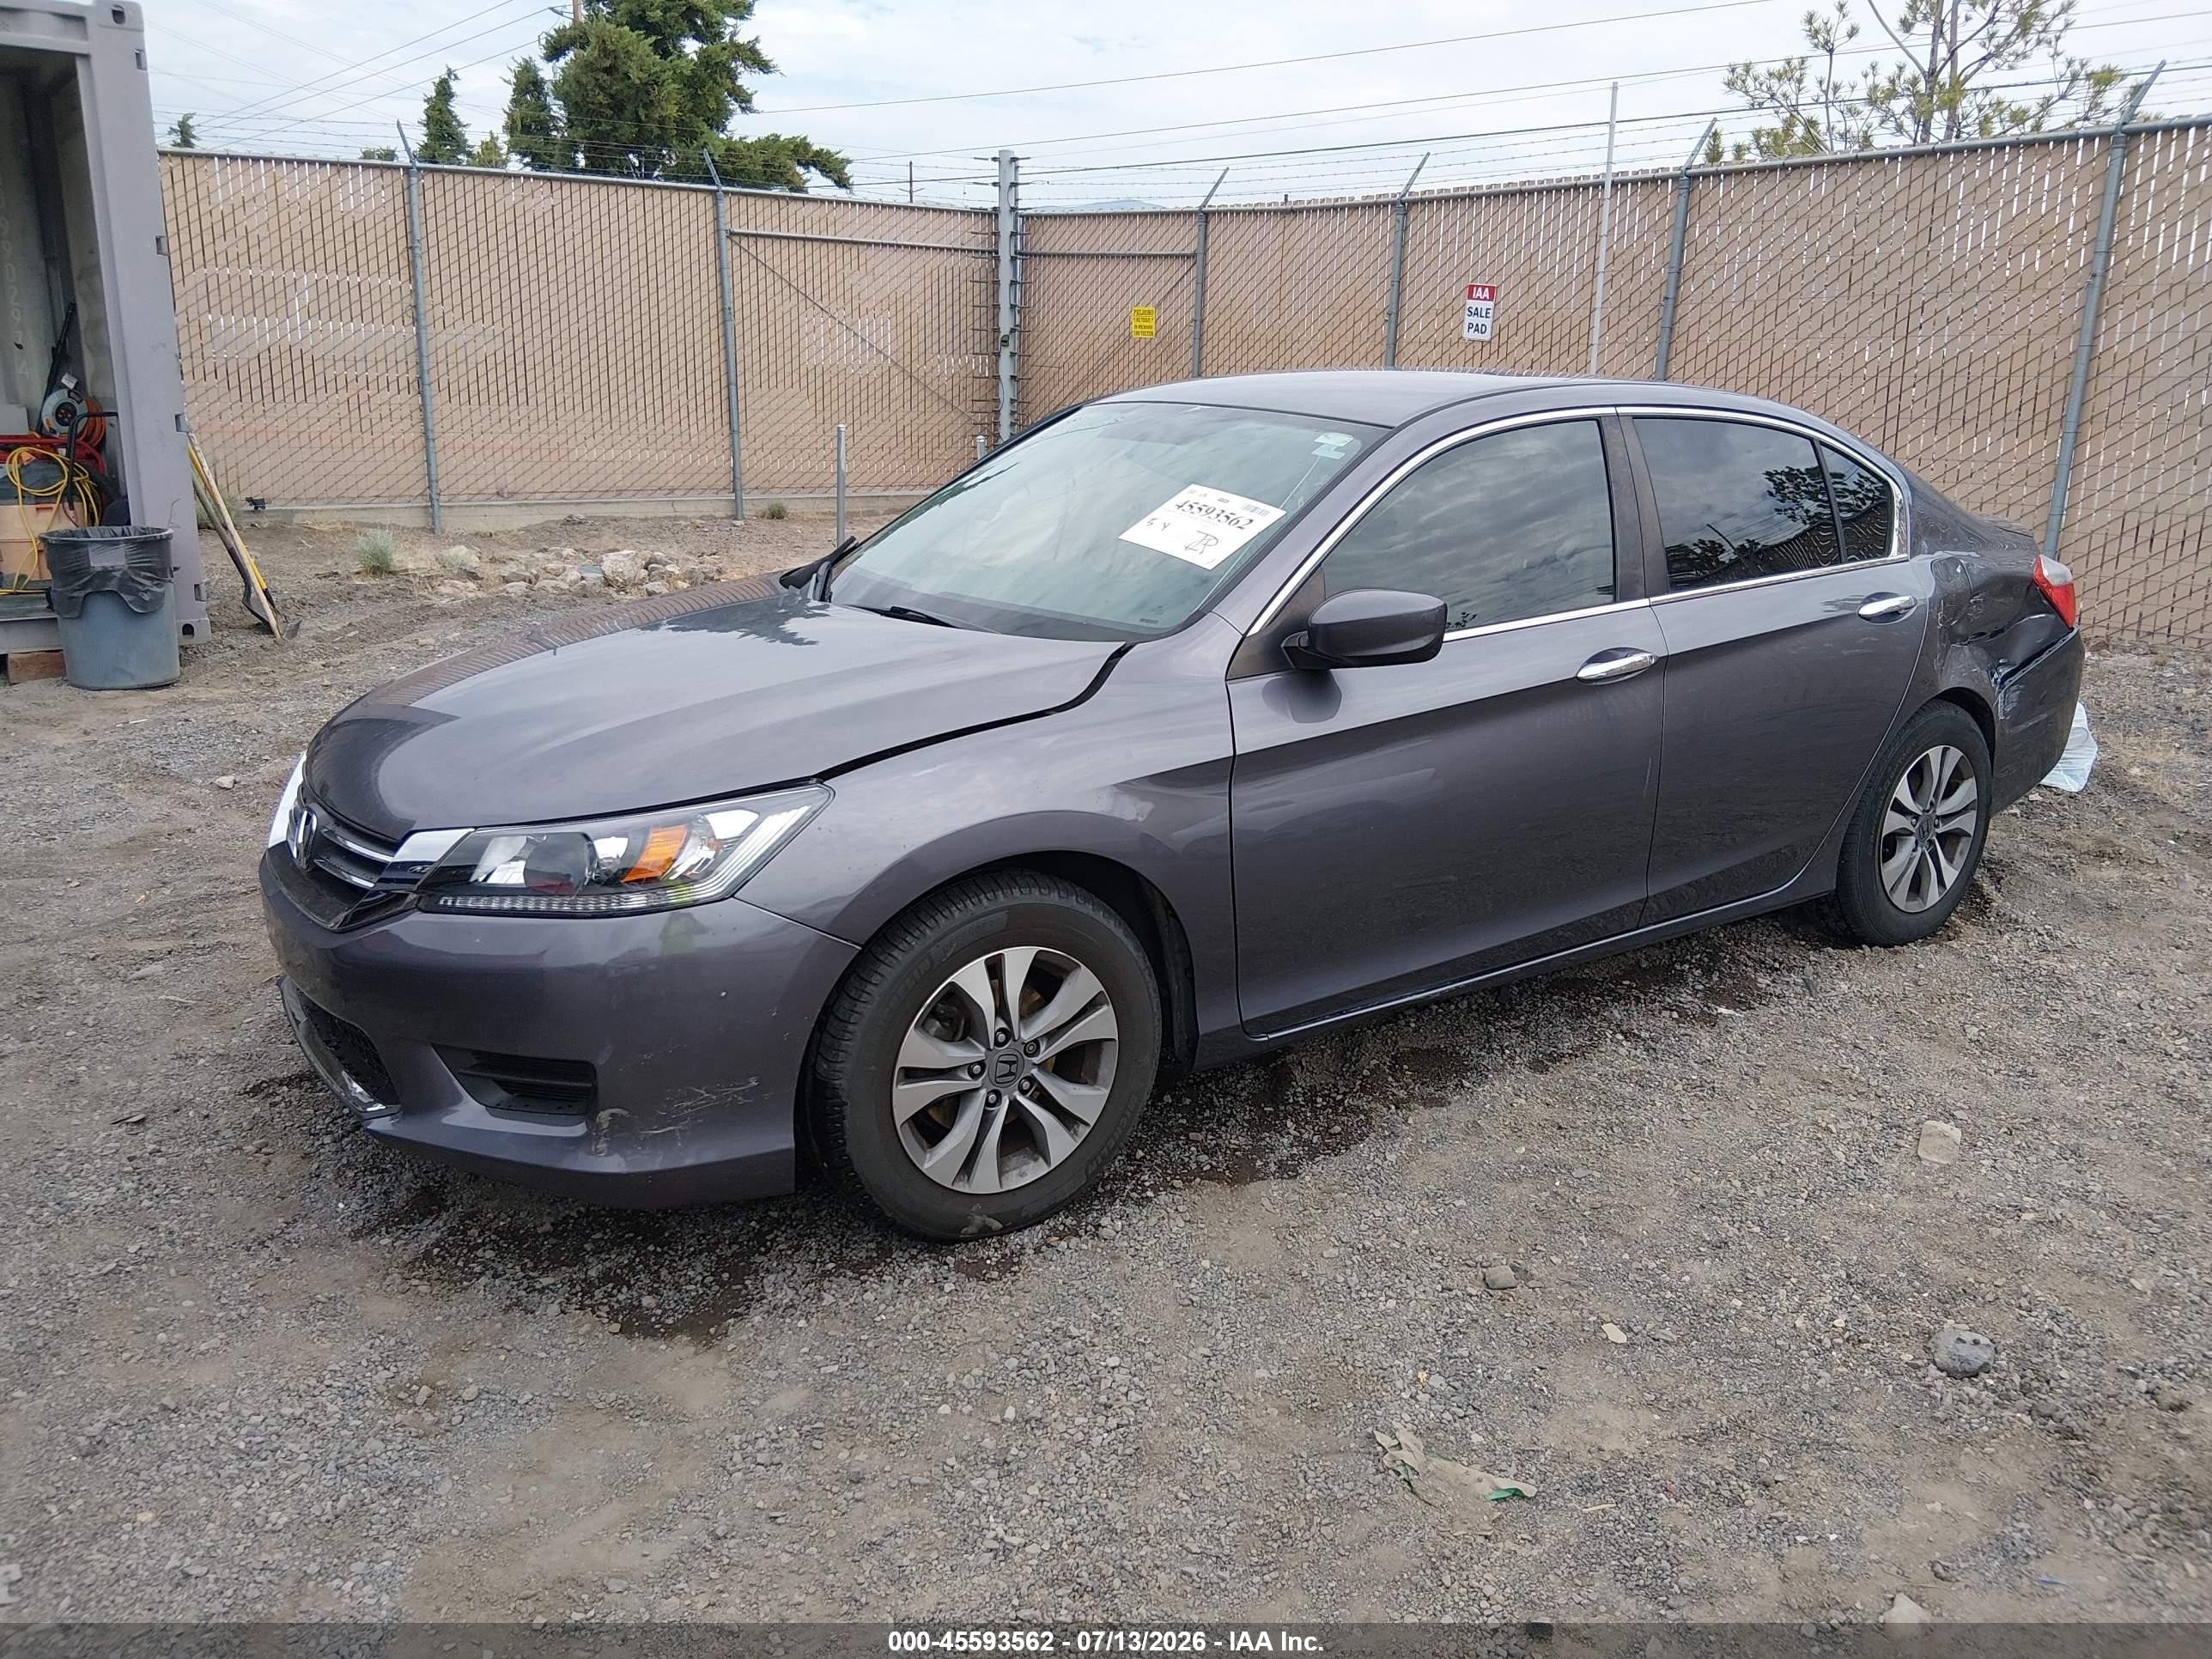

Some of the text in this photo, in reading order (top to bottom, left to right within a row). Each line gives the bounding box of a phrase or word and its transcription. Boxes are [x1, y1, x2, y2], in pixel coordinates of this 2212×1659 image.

[1473, 287, 1490, 300] IAA
[1467, 306, 1492, 319] SALE
[1467, 322, 1487, 335] PAD
[1175, 500, 1254, 530] 45593562
